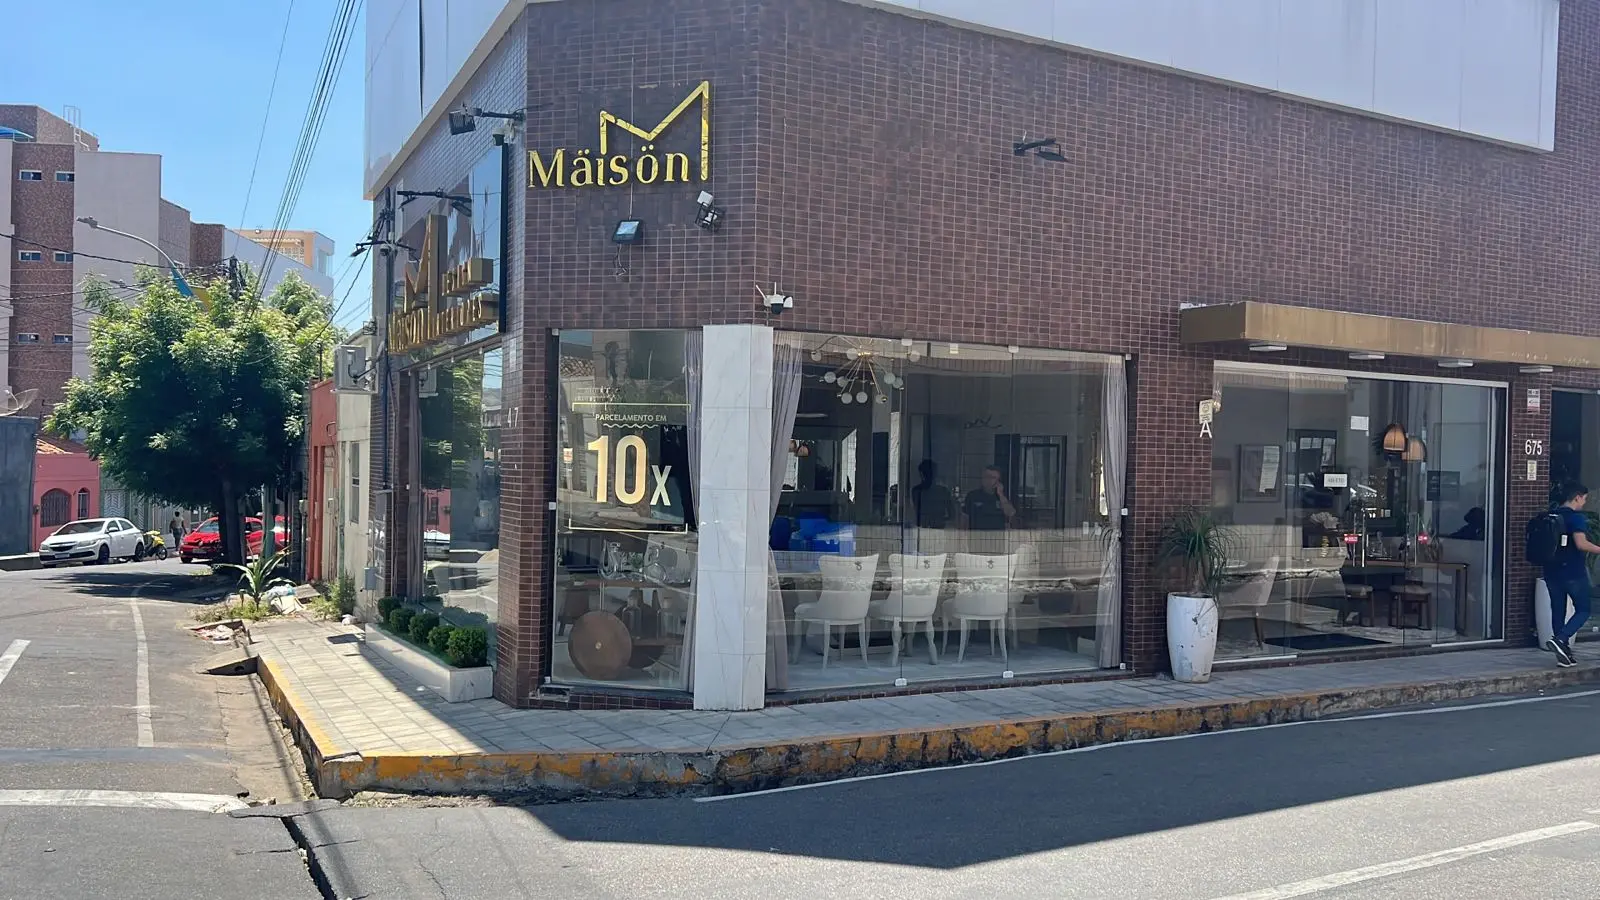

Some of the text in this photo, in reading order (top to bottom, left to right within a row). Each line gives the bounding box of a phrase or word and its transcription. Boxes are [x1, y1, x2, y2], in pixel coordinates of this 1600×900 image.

[594, 413, 667, 422] PARCELAMENTO EM
[1199, 420, 1213, 439] A
[1525, 439, 1543, 456] 675
